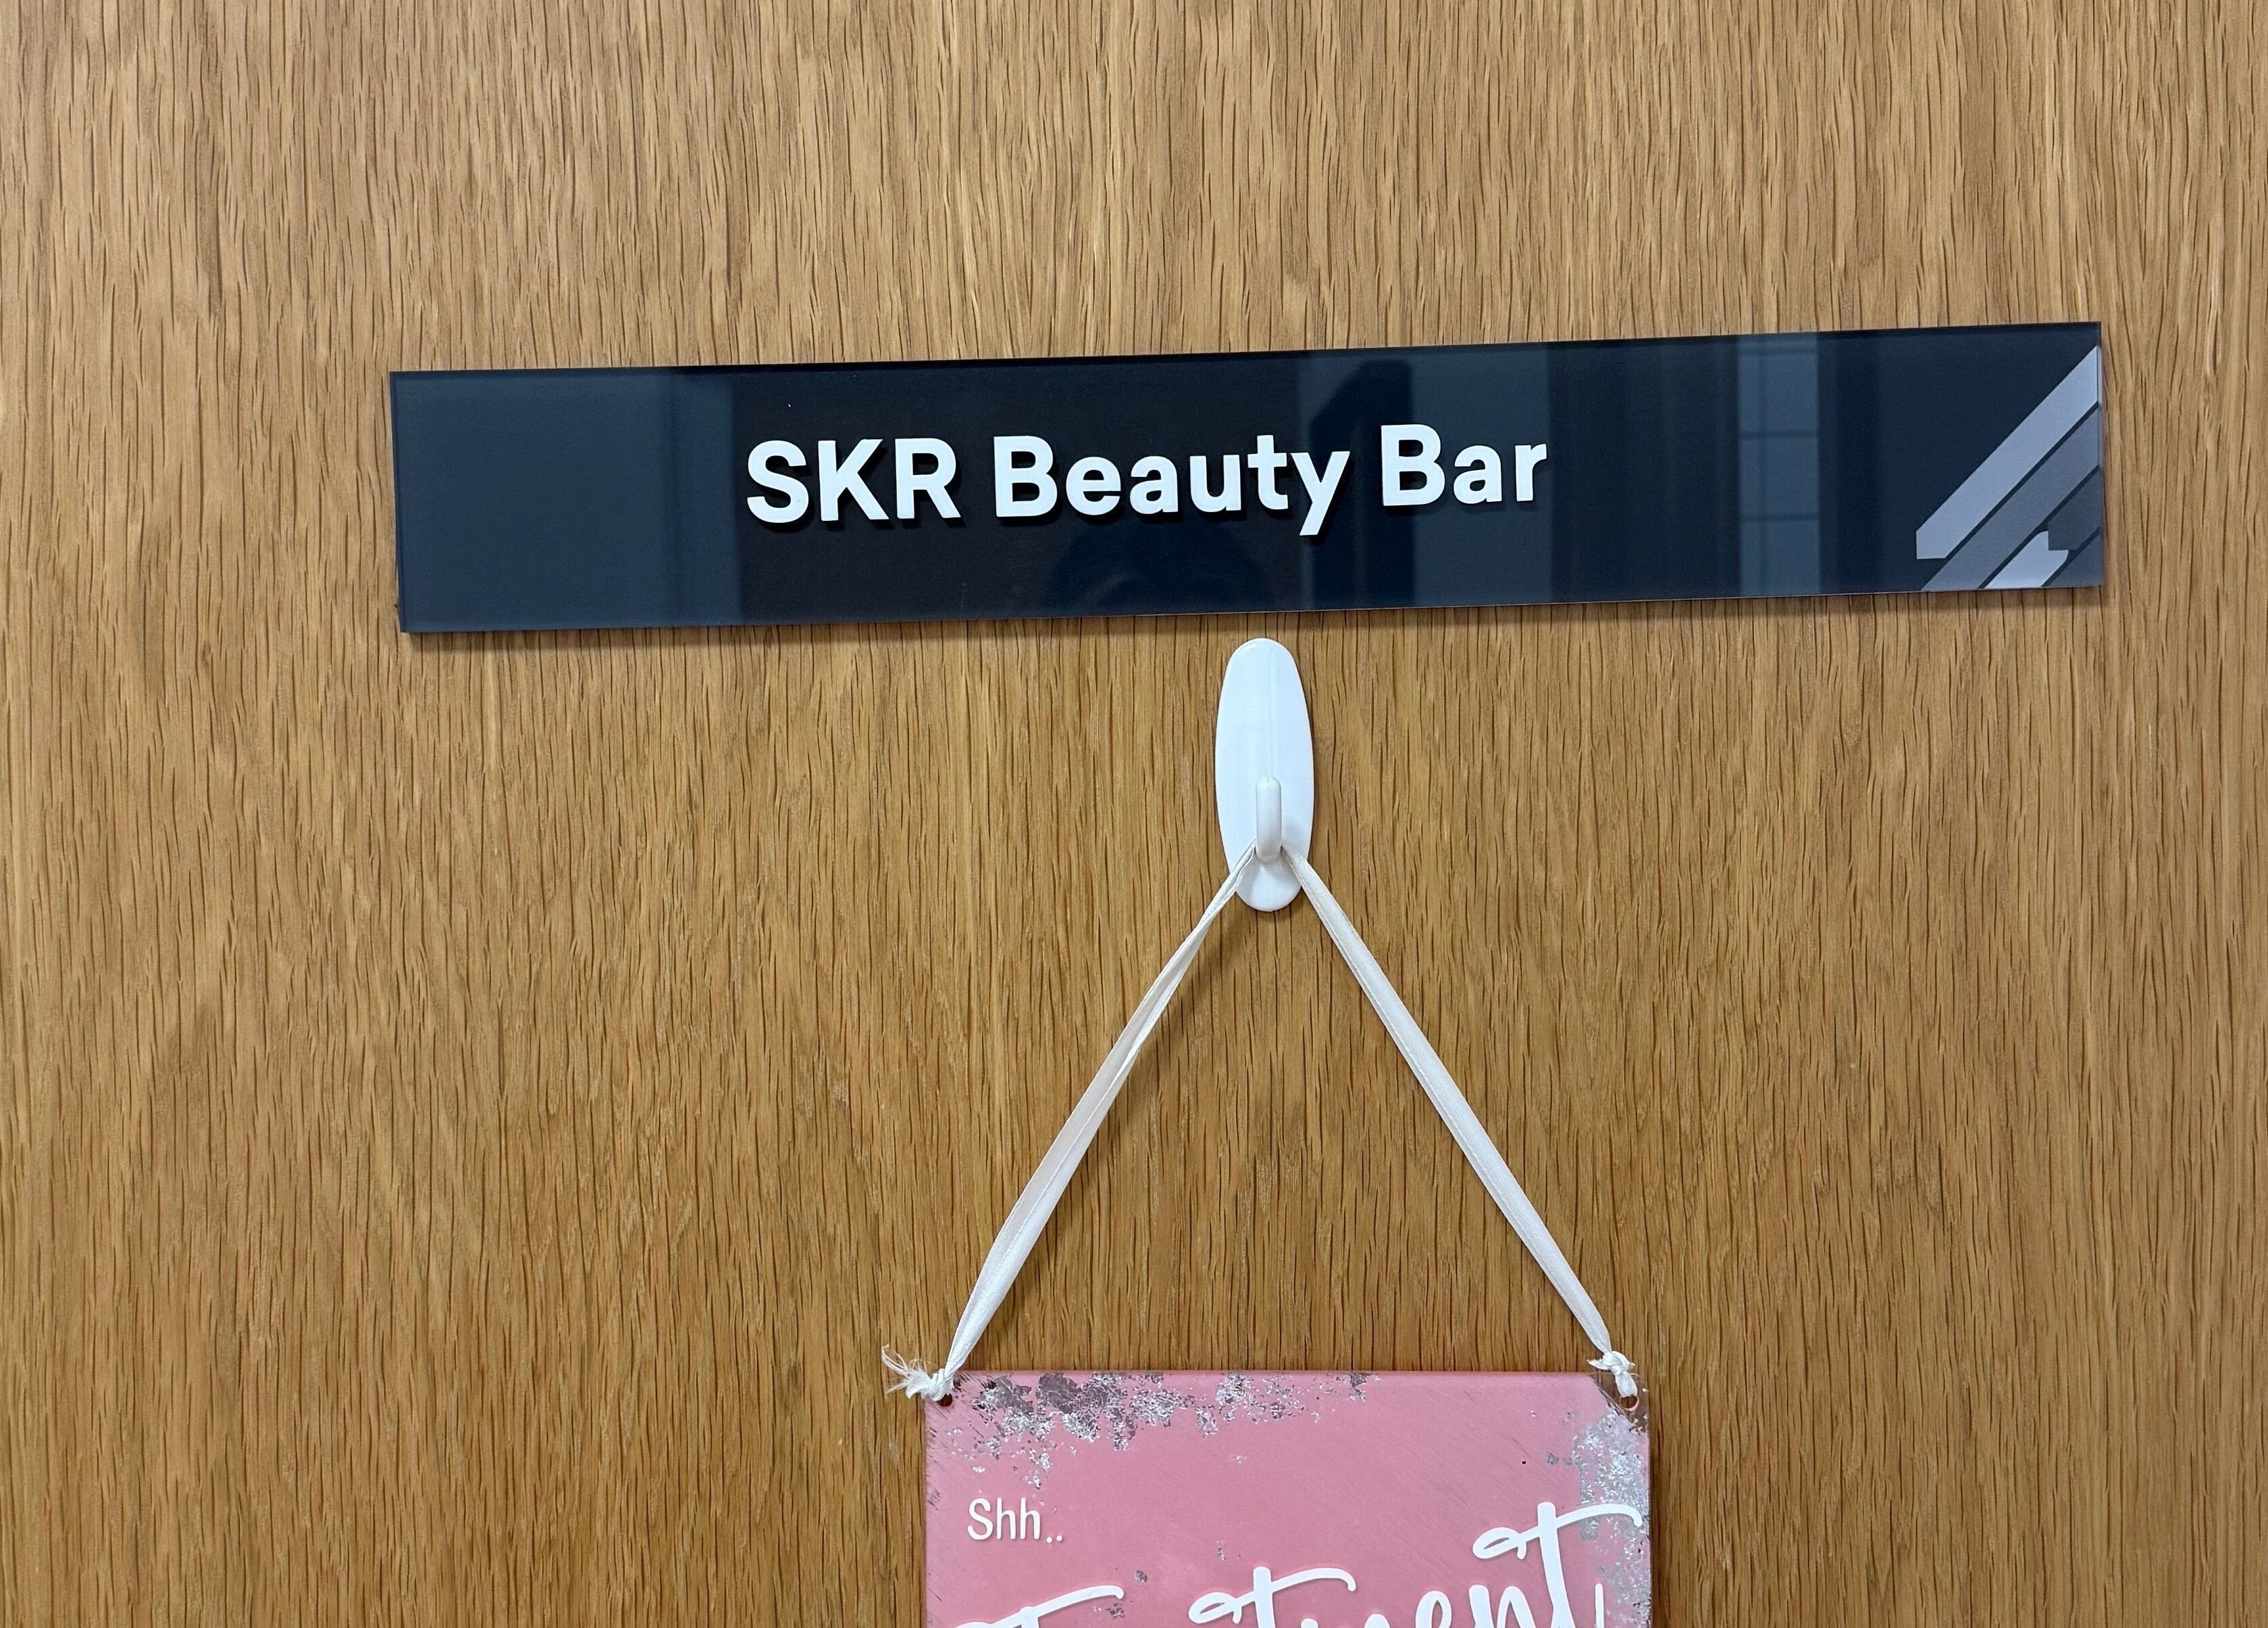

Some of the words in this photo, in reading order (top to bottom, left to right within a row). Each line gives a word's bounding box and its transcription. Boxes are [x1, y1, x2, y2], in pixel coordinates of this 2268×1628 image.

[746, 437, 962, 524] SKR
[993, 434, 1351, 537] Beauty
[1380, 423, 1548, 507] Bar
[967, 1496, 1064, 1544] Shh..
